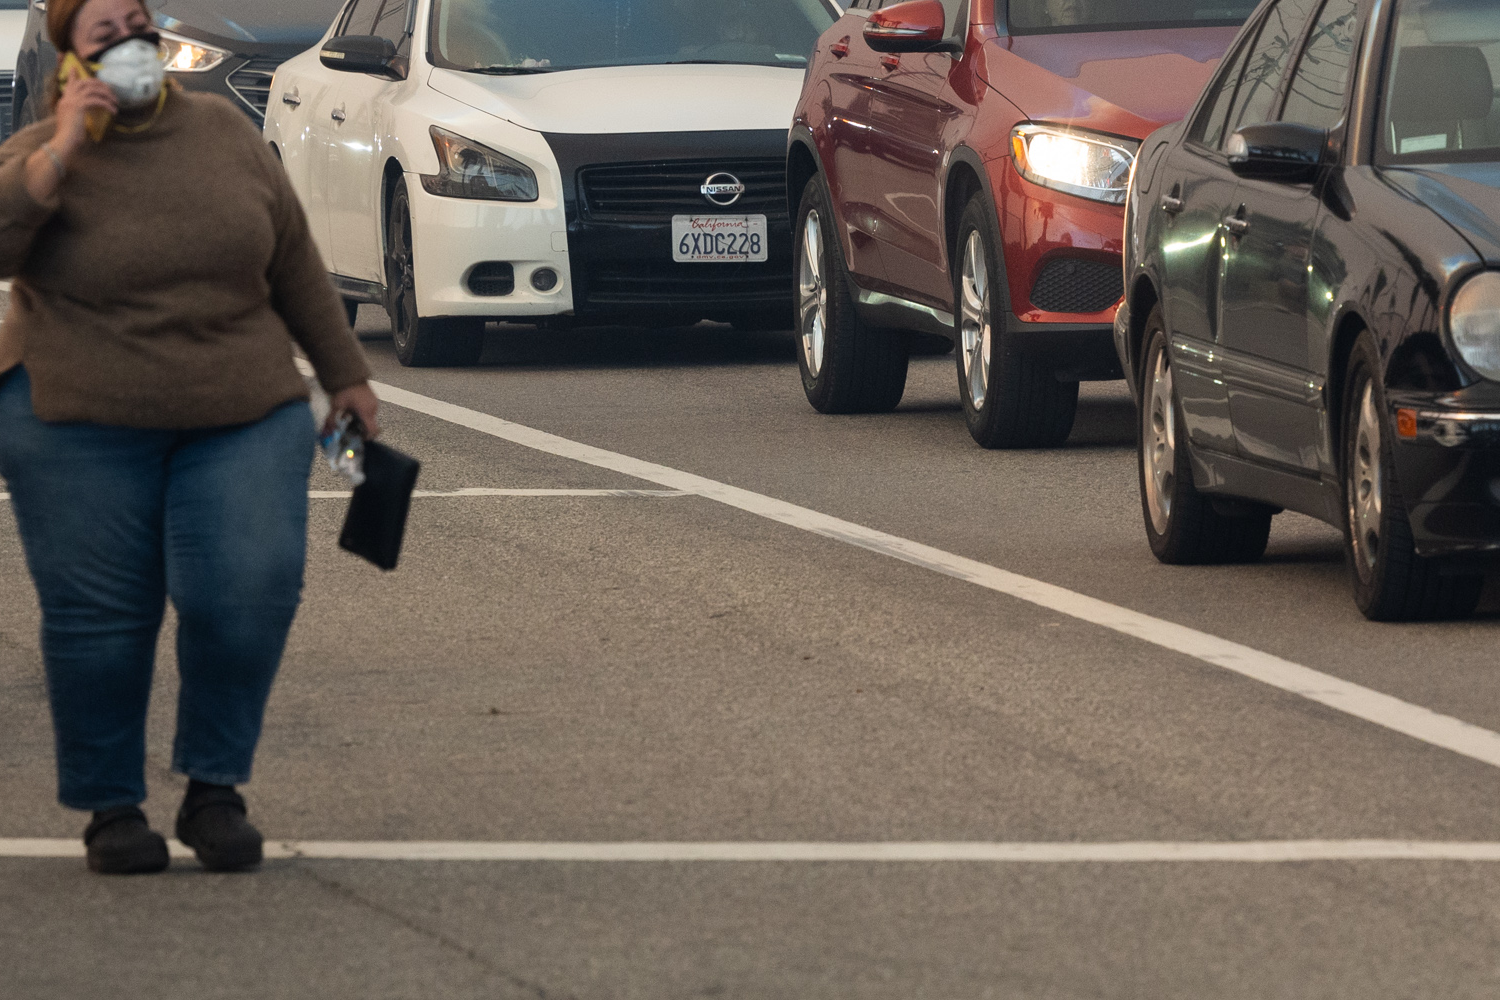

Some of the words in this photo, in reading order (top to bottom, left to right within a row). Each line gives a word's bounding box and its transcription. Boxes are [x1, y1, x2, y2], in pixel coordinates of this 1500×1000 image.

[706, 185, 741, 193] NISSAN
[691, 218, 749, 231] California
[679, 232, 761, 255] 6XDC228
